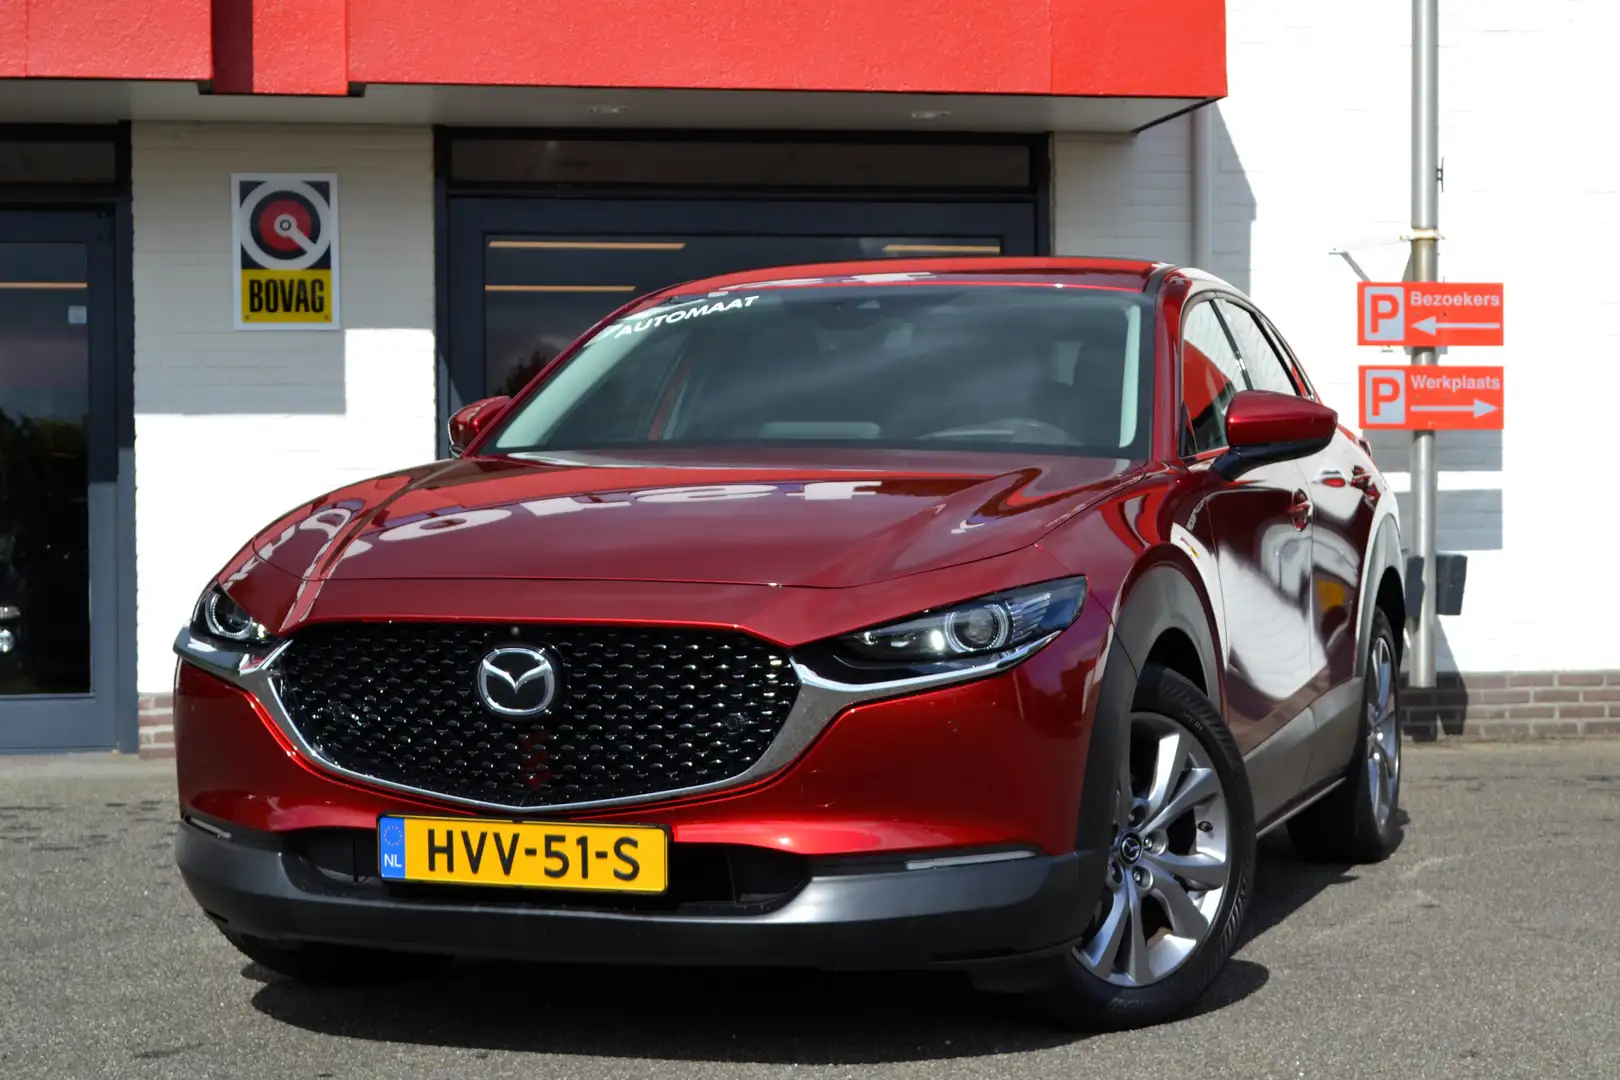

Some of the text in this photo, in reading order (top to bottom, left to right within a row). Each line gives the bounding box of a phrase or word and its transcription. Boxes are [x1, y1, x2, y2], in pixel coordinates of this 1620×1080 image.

[249, 279, 325, 313] BOVAG
[614, 295, 759, 339] AUTOMAAT
[1370, 291, 1500, 335] P Bezoekers
[1371, 374, 1500, 417] P Werkplaats
[384, 853, 402, 868] NL
[427, 828, 641, 882] HVV-51-S
